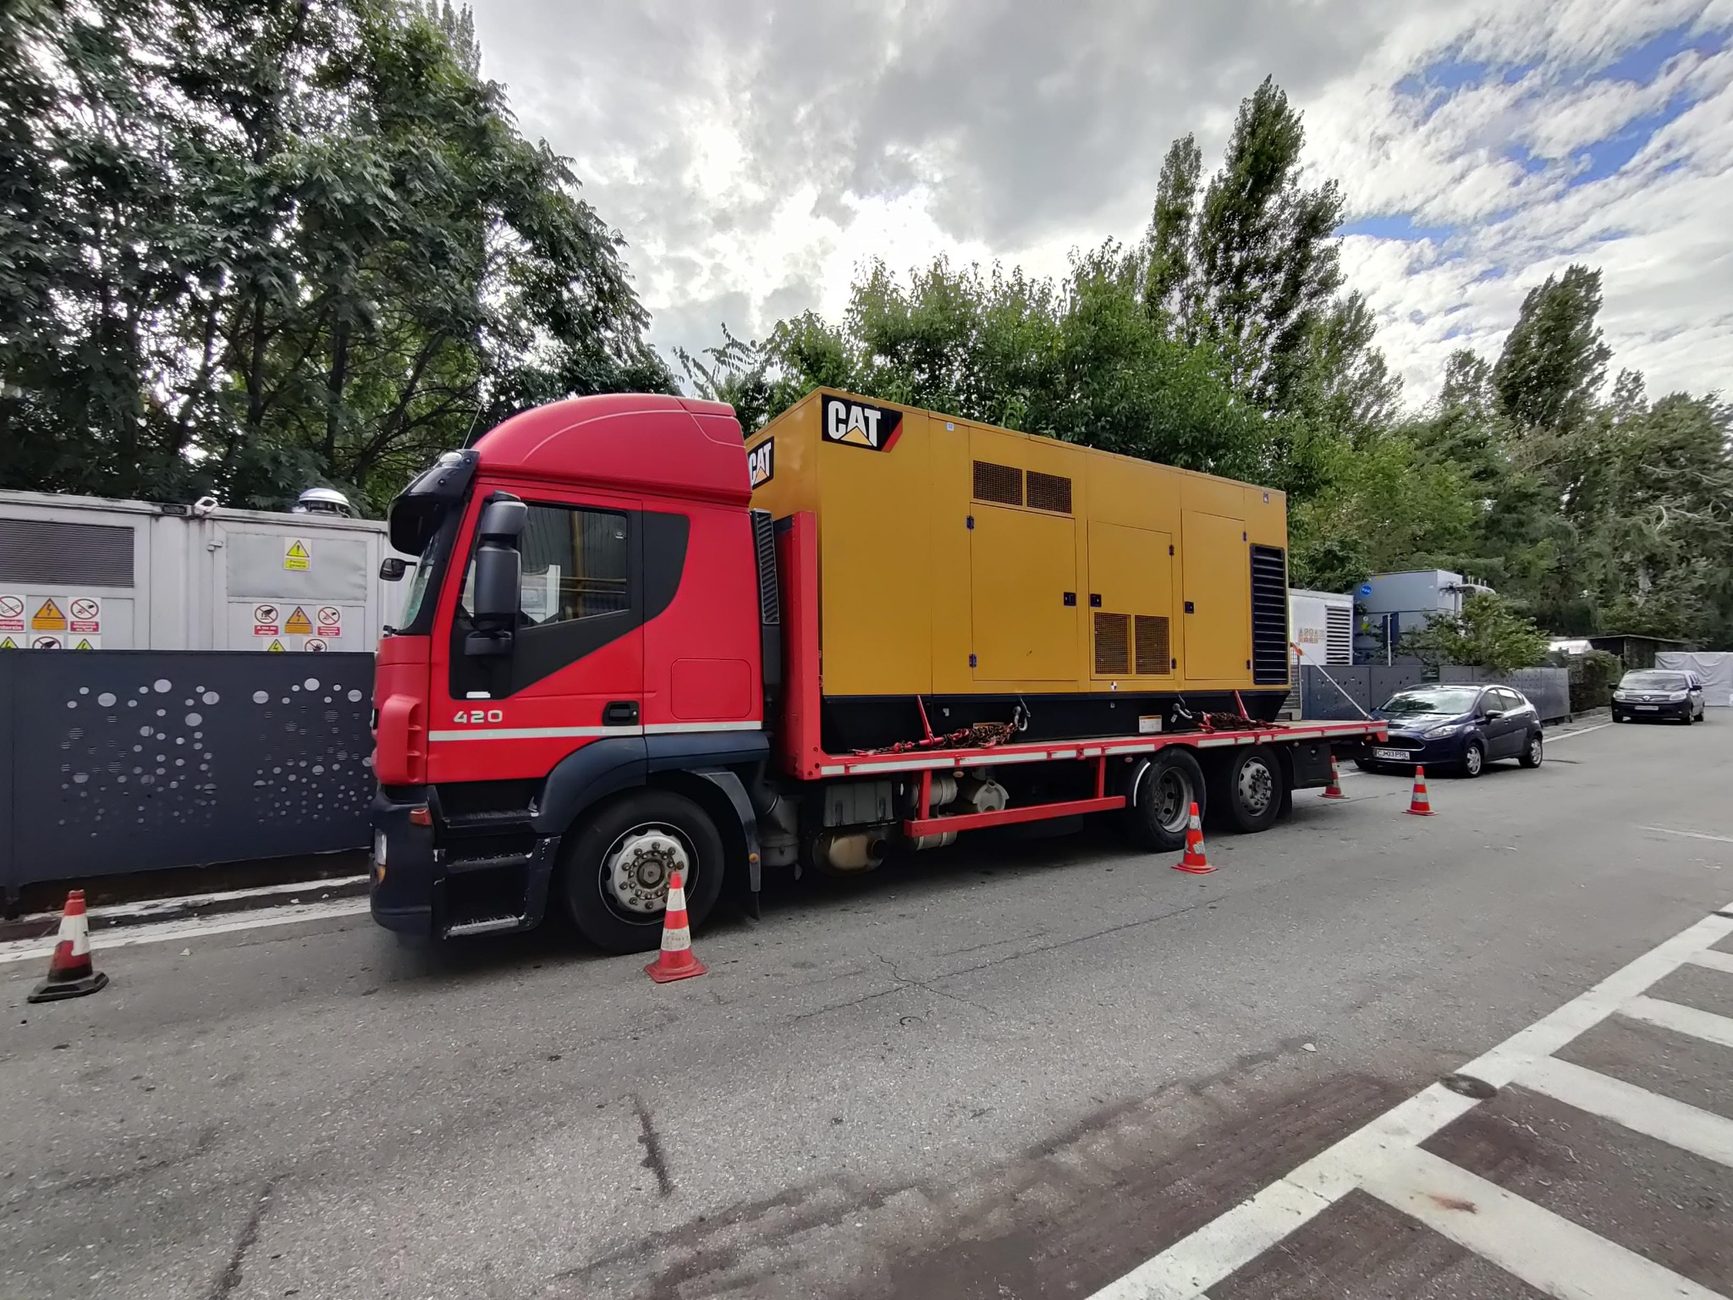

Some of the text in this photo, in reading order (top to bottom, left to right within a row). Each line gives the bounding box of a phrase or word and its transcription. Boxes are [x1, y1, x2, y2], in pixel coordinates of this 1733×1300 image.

[828, 400, 881, 447] CAT
[748, 442, 772, 486] CAT
[453, 709, 503, 724] 420
